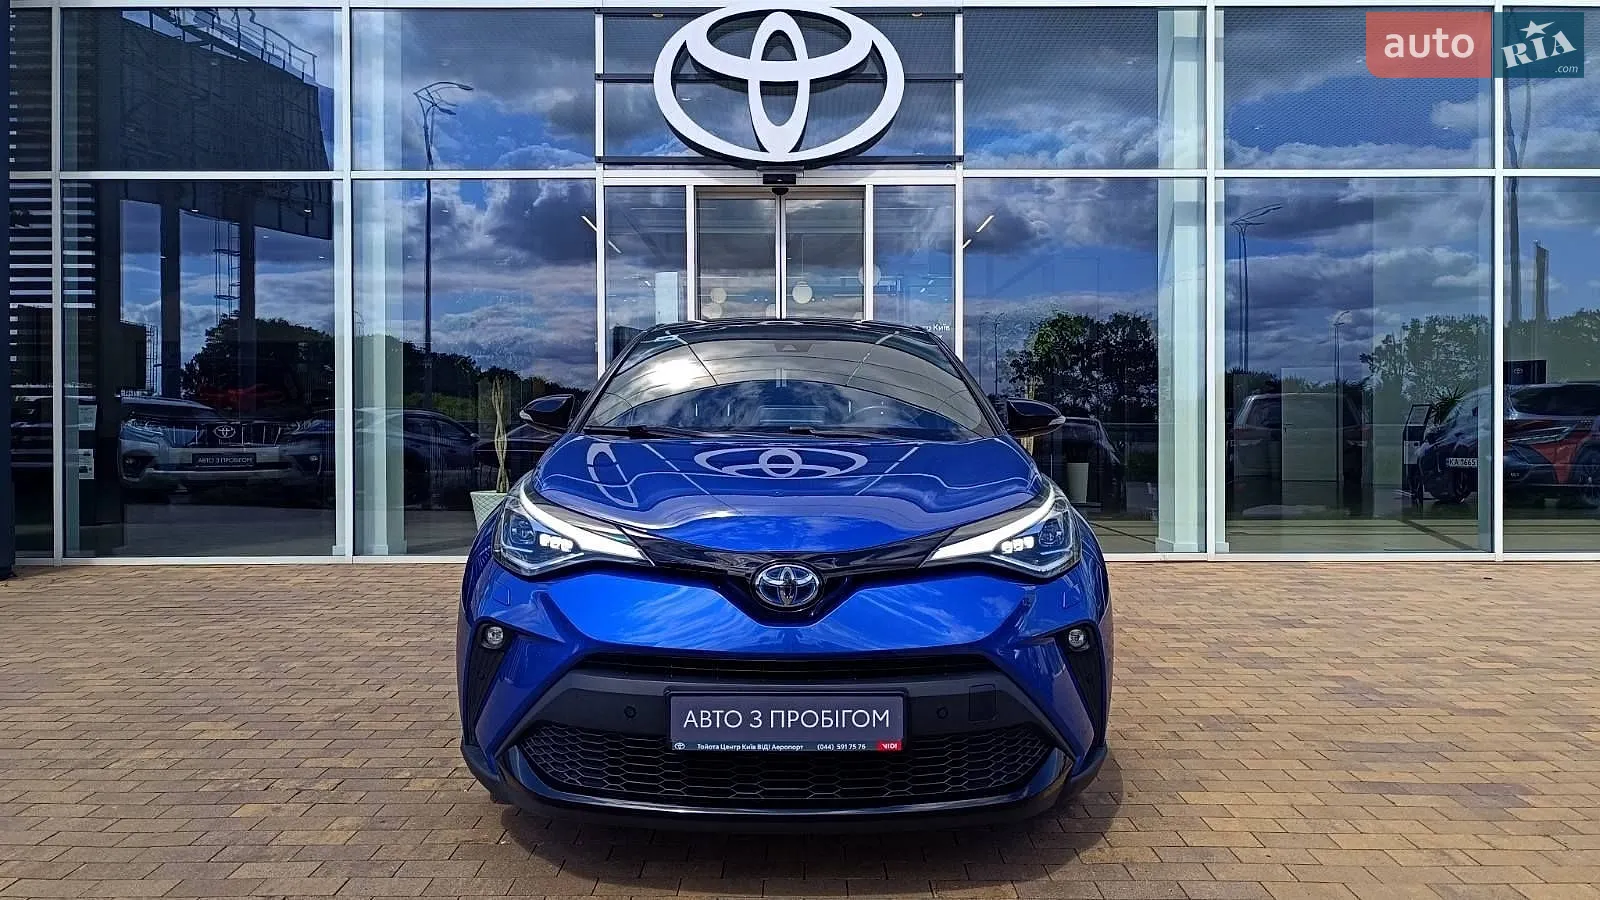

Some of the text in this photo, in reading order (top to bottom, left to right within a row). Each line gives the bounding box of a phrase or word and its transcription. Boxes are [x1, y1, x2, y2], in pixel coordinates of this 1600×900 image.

[683, 709, 890, 728] АВТО З ПРОБІГОМ
[720, 743, 741, 751] Центр
[771, 743, 804, 751] Аеропорт
[817, 743, 835, 751] (044)
